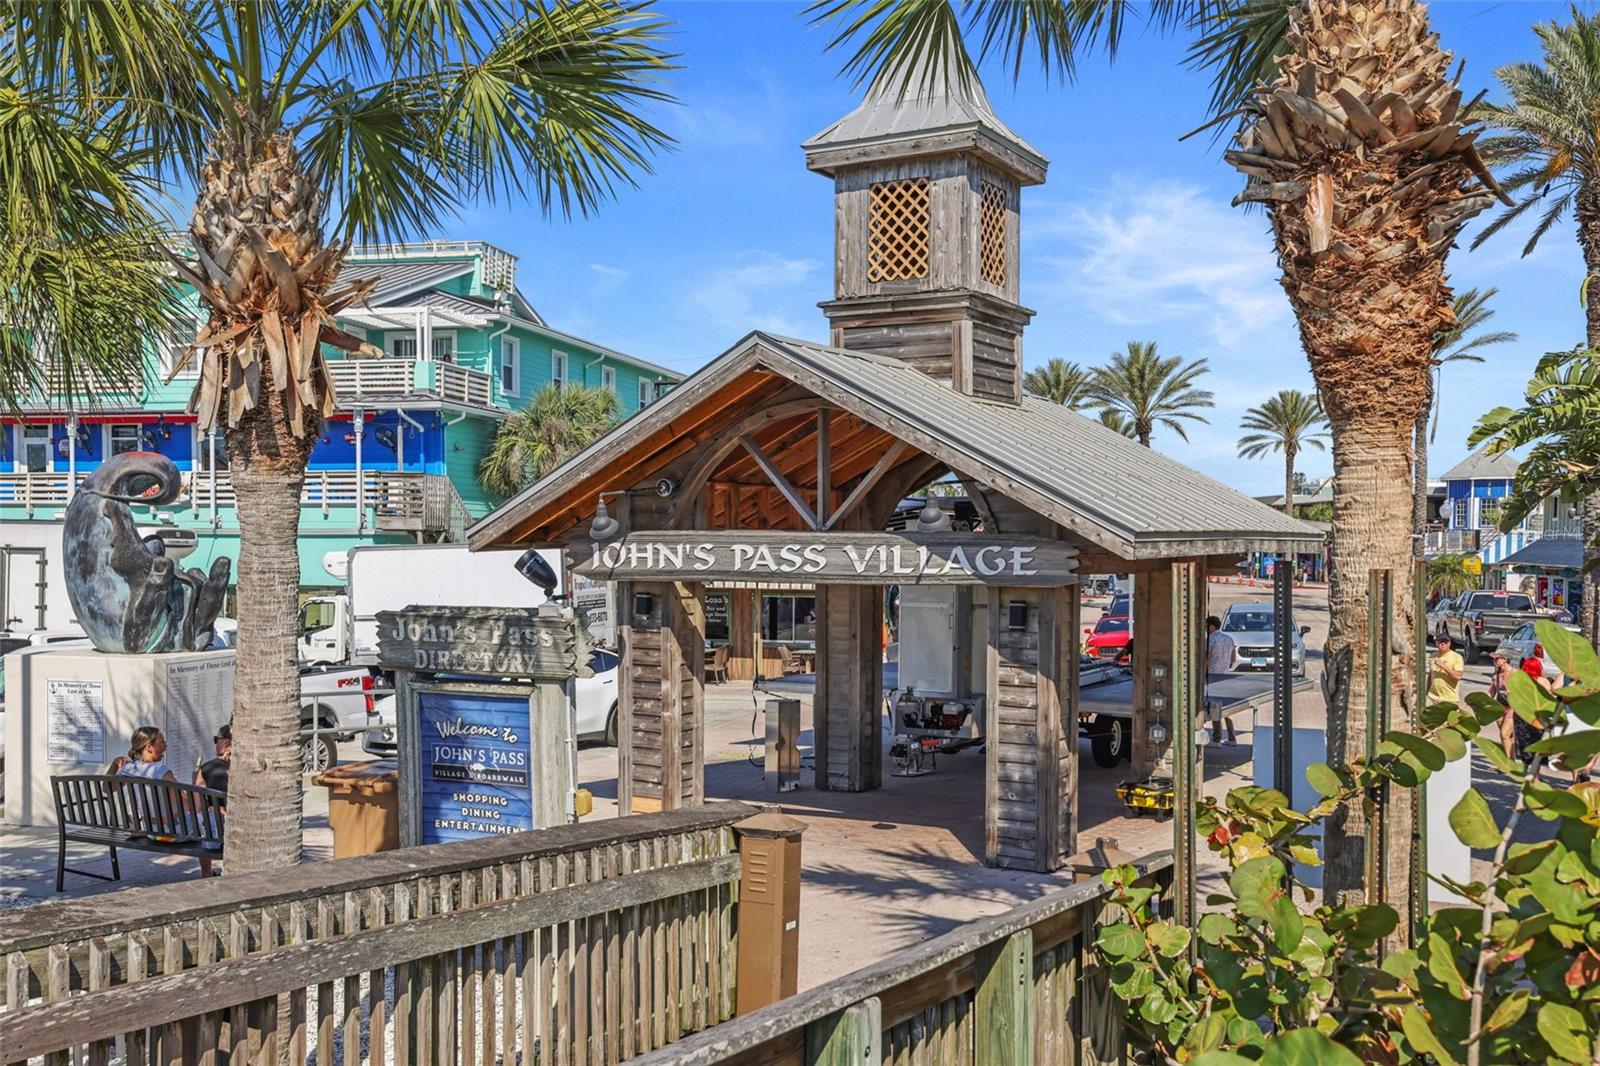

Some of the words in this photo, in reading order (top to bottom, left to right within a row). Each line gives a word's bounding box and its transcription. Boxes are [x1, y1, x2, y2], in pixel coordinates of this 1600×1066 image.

[591, 542, 716, 571] JOHN'S
[730, 543, 828, 573] PASS
[842, 545, 1039, 576] VILLAGE
[392, 617, 476, 643] John's
[490, 619, 553, 647] Pass
[414, 649, 537, 673] DIRECTORY
[436, 717, 498, 739] Welcome
[503, 727, 518, 743] to
[434, 746, 486, 762] JOHN'S
[493, 750, 525, 766] PASS
[434, 769, 466, 779] VILLAGE
[477, 773, 525, 784] BOARDWALK
[453, 793, 508, 806] SHOPPING
[461, 808, 501, 820] DINING
